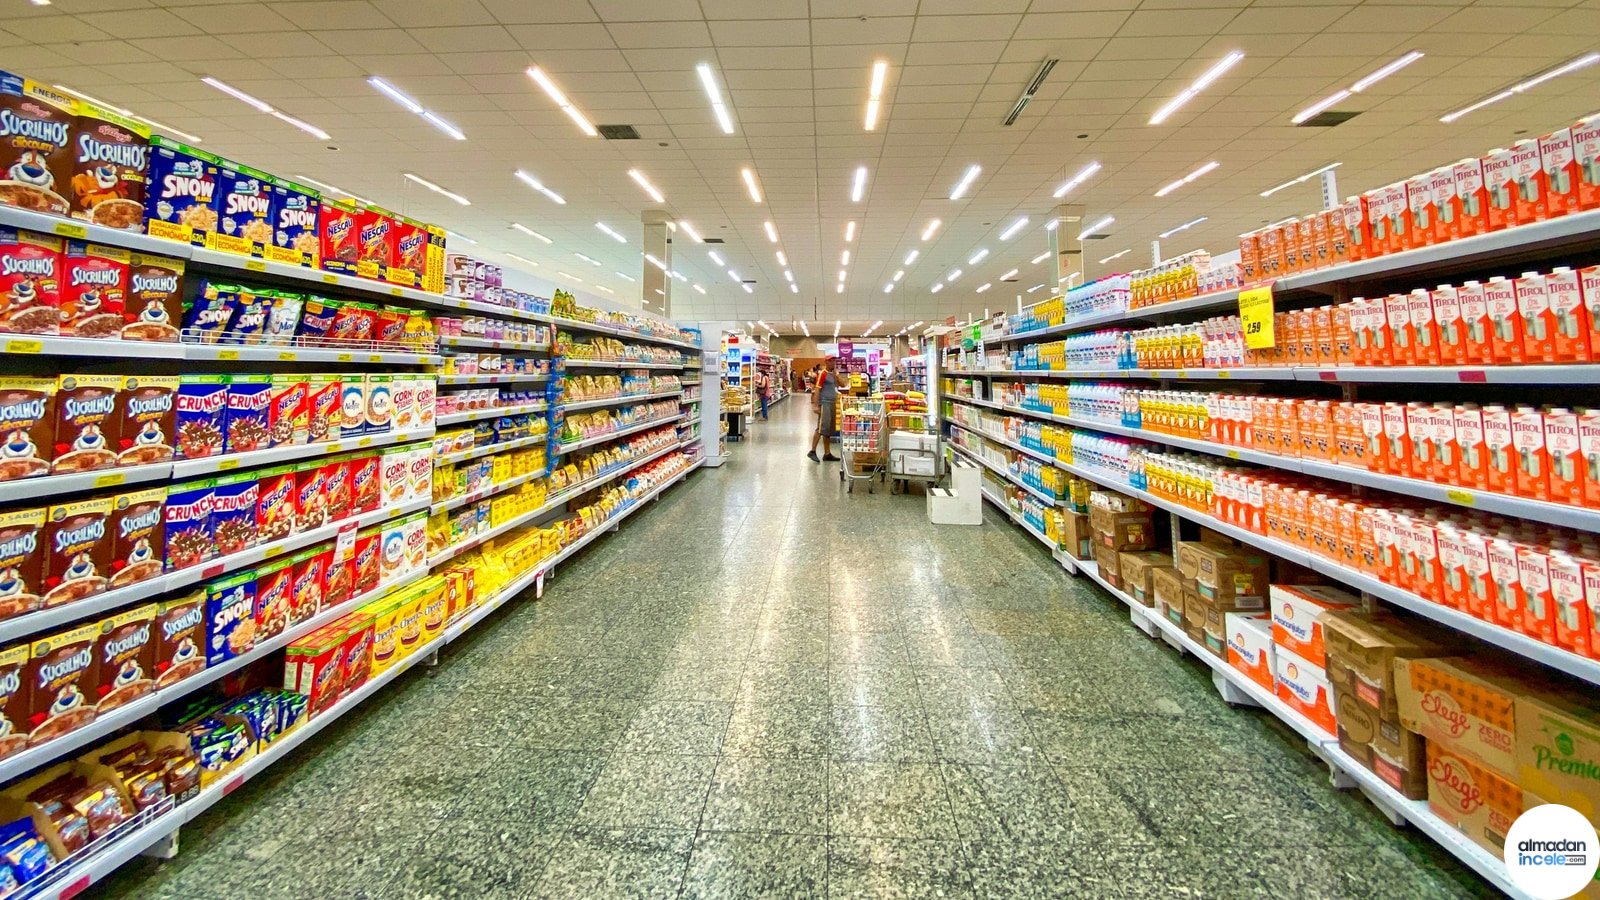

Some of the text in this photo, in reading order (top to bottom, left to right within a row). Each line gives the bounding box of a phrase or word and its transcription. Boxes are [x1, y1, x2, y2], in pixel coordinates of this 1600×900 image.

[0, 110, 69, 147] SUCRILHOS
[79, 133, 147, 172] SUCRILHOS
[1542, 140, 1571, 156] TIROL
[1484, 158, 1510, 175] TIROL
[1511, 149, 1539, 167] TIROL
[1431, 177, 1455, 191] TIROL
[1456, 168, 1481, 184] TIROL
[162, 174, 215, 199] SNOW
[1409, 184, 1429, 197] TIROL
[226, 192, 270, 215] SNOW
[279, 208, 316, 229] SNOW
[327, 217, 354, 238] NESCAU
[360, 221, 390, 244] NESCAU
[399, 234, 424, 254] NESCAU
[2, 255, 54, 277] SUCRILHOS
[72, 264, 120, 287] SUCRILHOS
[132, 274, 178, 294] SUCRILHOS
[1517, 284, 1547, 298] TIROL
[1548, 281, 1577, 295] TIROL
[1434, 296, 1458, 307] TIROL
[1461, 292, 1484, 304] TIROL
[1486, 289, 1513, 302] TIROL
[1410, 300, 1430, 311] TIROL
[194, 310, 234, 325] SNOW
[235, 312, 266, 329] SNO
[304, 314, 333, 329] CRUNC
[177, 390, 227, 411] CRUNCH
[228, 389, 272, 410] CRUNCH
[279, 388, 305, 411] NESCAU
[316, 387, 339, 408] NESCAU
[393, 388, 413, 404] CORN
[417, 388, 434, 403] CORN
[0, 398, 47, 422] UCRILHOS
[65, 394, 115, 421] SUCRILHOS
[128, 392, 173, 419] SUCRILHOS
[1408, 415, 1428, 425] TIROL
[1430, 417, 1453, 427] TIROL
[1456, 418, 1481, 430] TIROL
[1484, 420, 1510, 432] TIROL
[1513, 422, 1542, 434] TIROL
[1546, 424, 1577, 437] TIROL
[385, 460, 405, 479] CORN
[411, 457, 429, 473] CORN
[354, 462, 377, 489] NESCAU
[214, 486, 258, 510] CRUNCH
[261, 479, 292, 513] NESCAU
[300, 474, 326, 505] NESCAU
[166, 494, 214, 520] CRUNCH
[121, 506, 161, 538] SUCRILHOS
[56, 518, 106, 553] SUCRILHOS
[407, 529, 425, 546] CORN
[1413, 532, 1434, 546] TIROL
[356, 539, 379, 569] NESCAU
[1439, 540, 1461, 555] TIROL
[1462, 546, 1486, 561] TIROL
[1490, 554, 1515, 569] TIROL
[1519, 560, 1546, 576] TIROL
[292, 561, 319, 598] NESCAU
[1550, 569, 1580, 585] TIROL
[163, 605, 201, 641] SUCRILHOS
[213, 596, 254, 634] SNOW
[105, 623, 150, 664] SUCRILHOS
[39, 645, 92, 689] SUCRILHOS
[1479, 723, 1512, 746] ZERO
